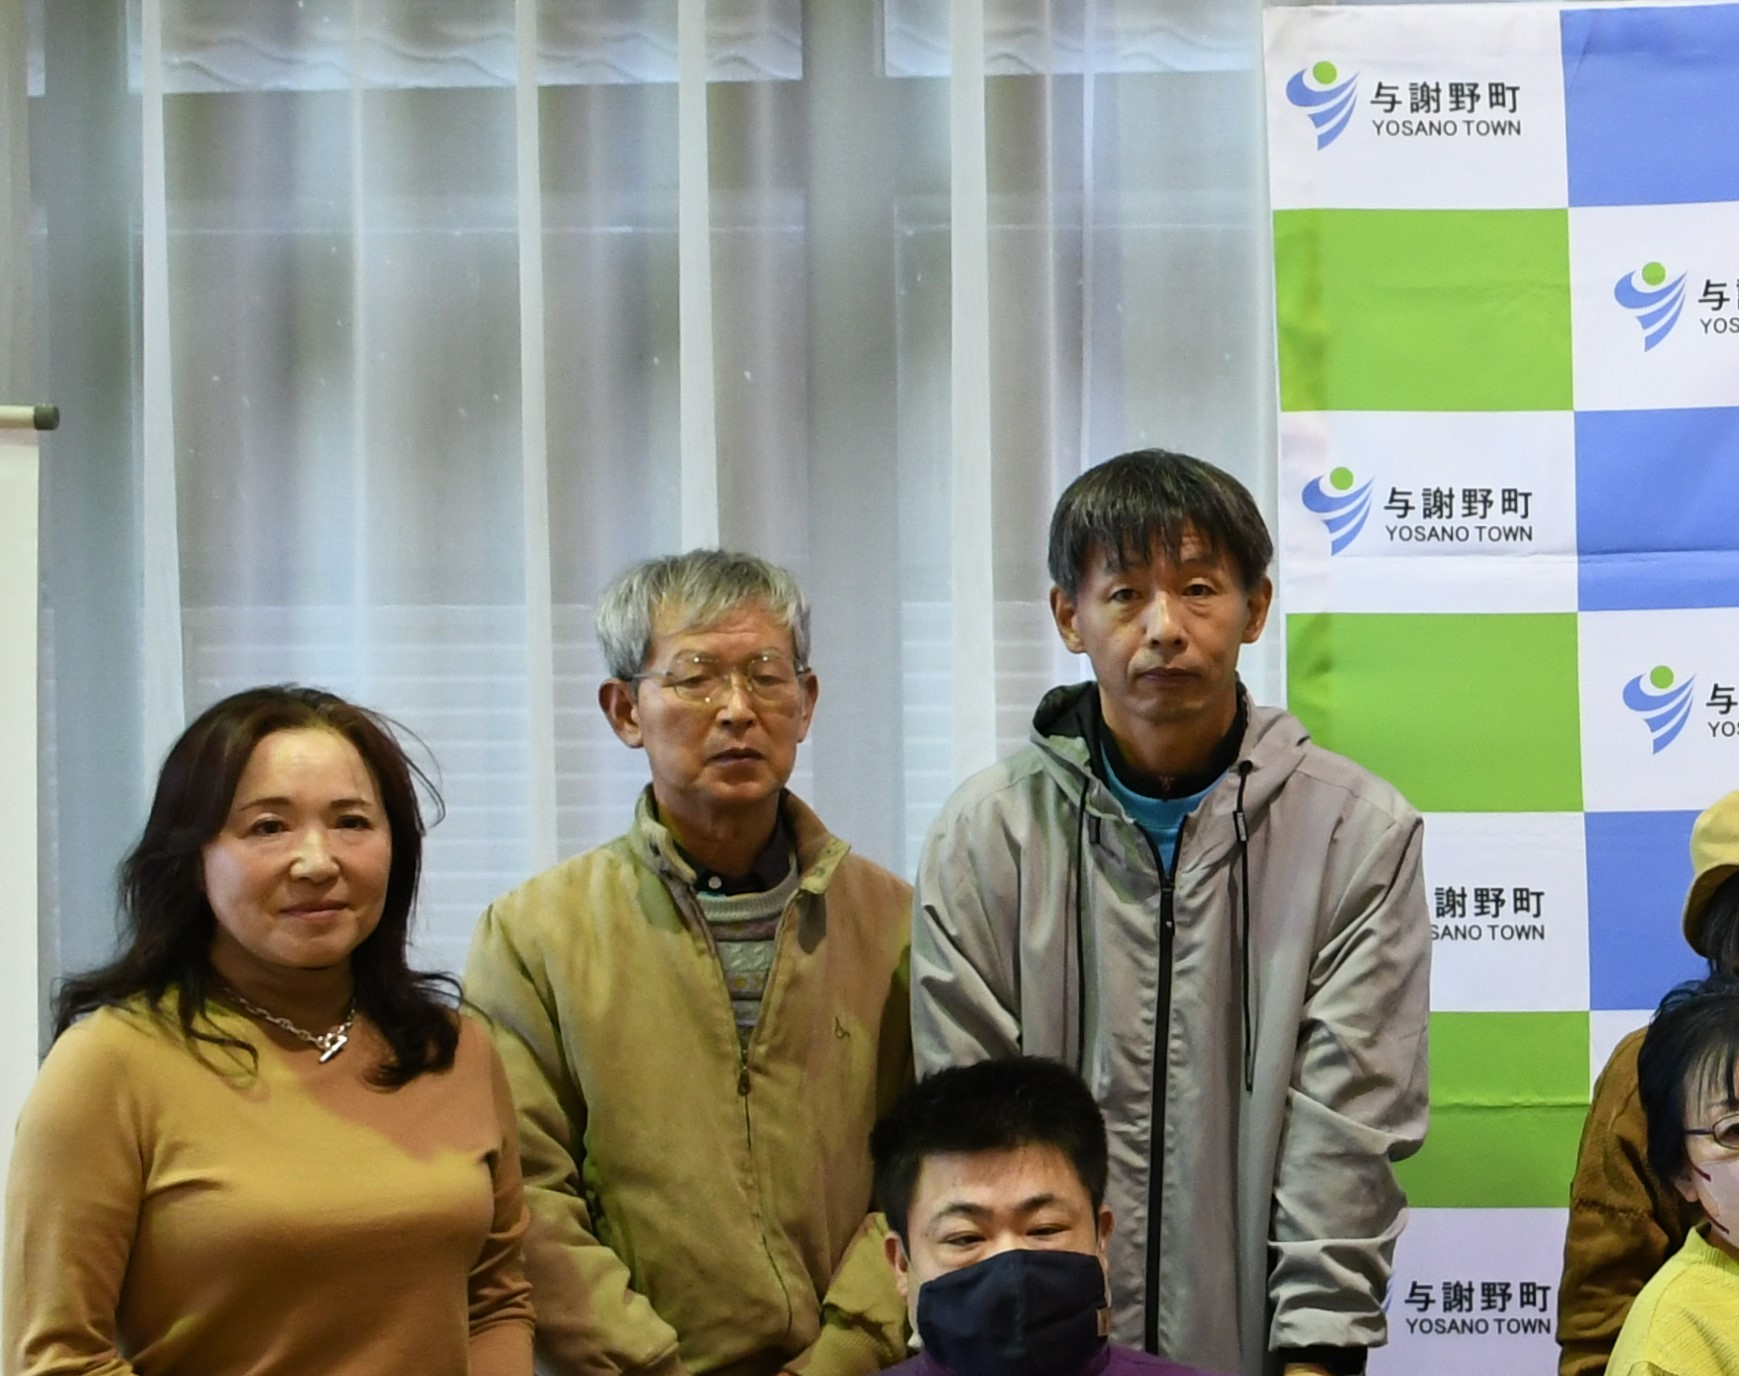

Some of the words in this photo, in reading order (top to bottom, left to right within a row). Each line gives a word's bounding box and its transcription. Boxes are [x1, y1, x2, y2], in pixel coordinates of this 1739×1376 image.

[1370, 81, 1521, 114] 与謝野町
[1372, 119, 1460, 137] YOSANO
[1468, 119, 1521, 137] TOWN
[1383, 486, 1533, 520] 与謝野町
[1385, 525, 1470, 543] YOSANO
[1474, 525, 1533, 543] TOWN
[1486, 924, 1545, 941] TOWN
[1403, 1280, 1552, 1313] 与謝野町
[1405, 1317, 1490, 1335] YOSANO
[1493, 1317, 1551, 1335] TOWN
